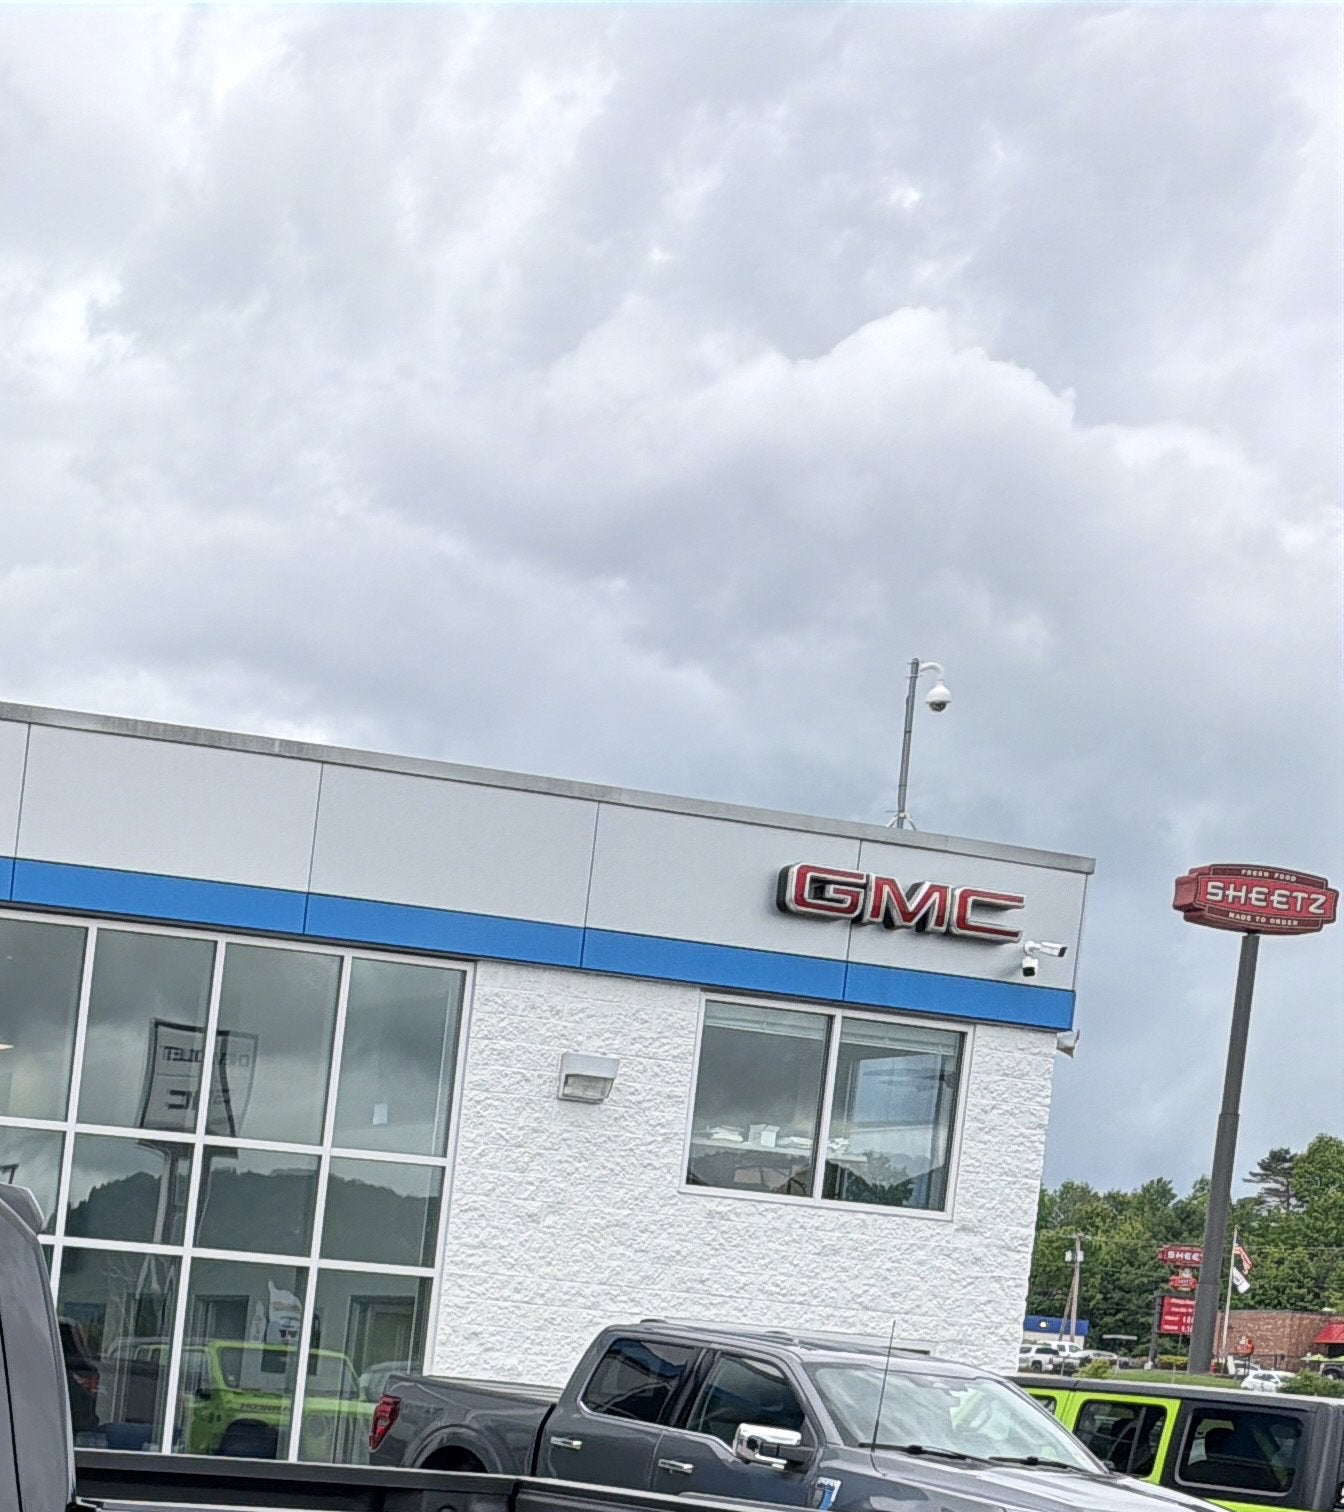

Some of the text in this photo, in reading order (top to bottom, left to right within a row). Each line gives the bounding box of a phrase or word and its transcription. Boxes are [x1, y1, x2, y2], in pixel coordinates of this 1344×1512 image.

[776, 862, 1027, 944] GMC
[1206, 881, 1327, 914] SHEETZ
[1167, 1250, 1204, 1261] SHEE
